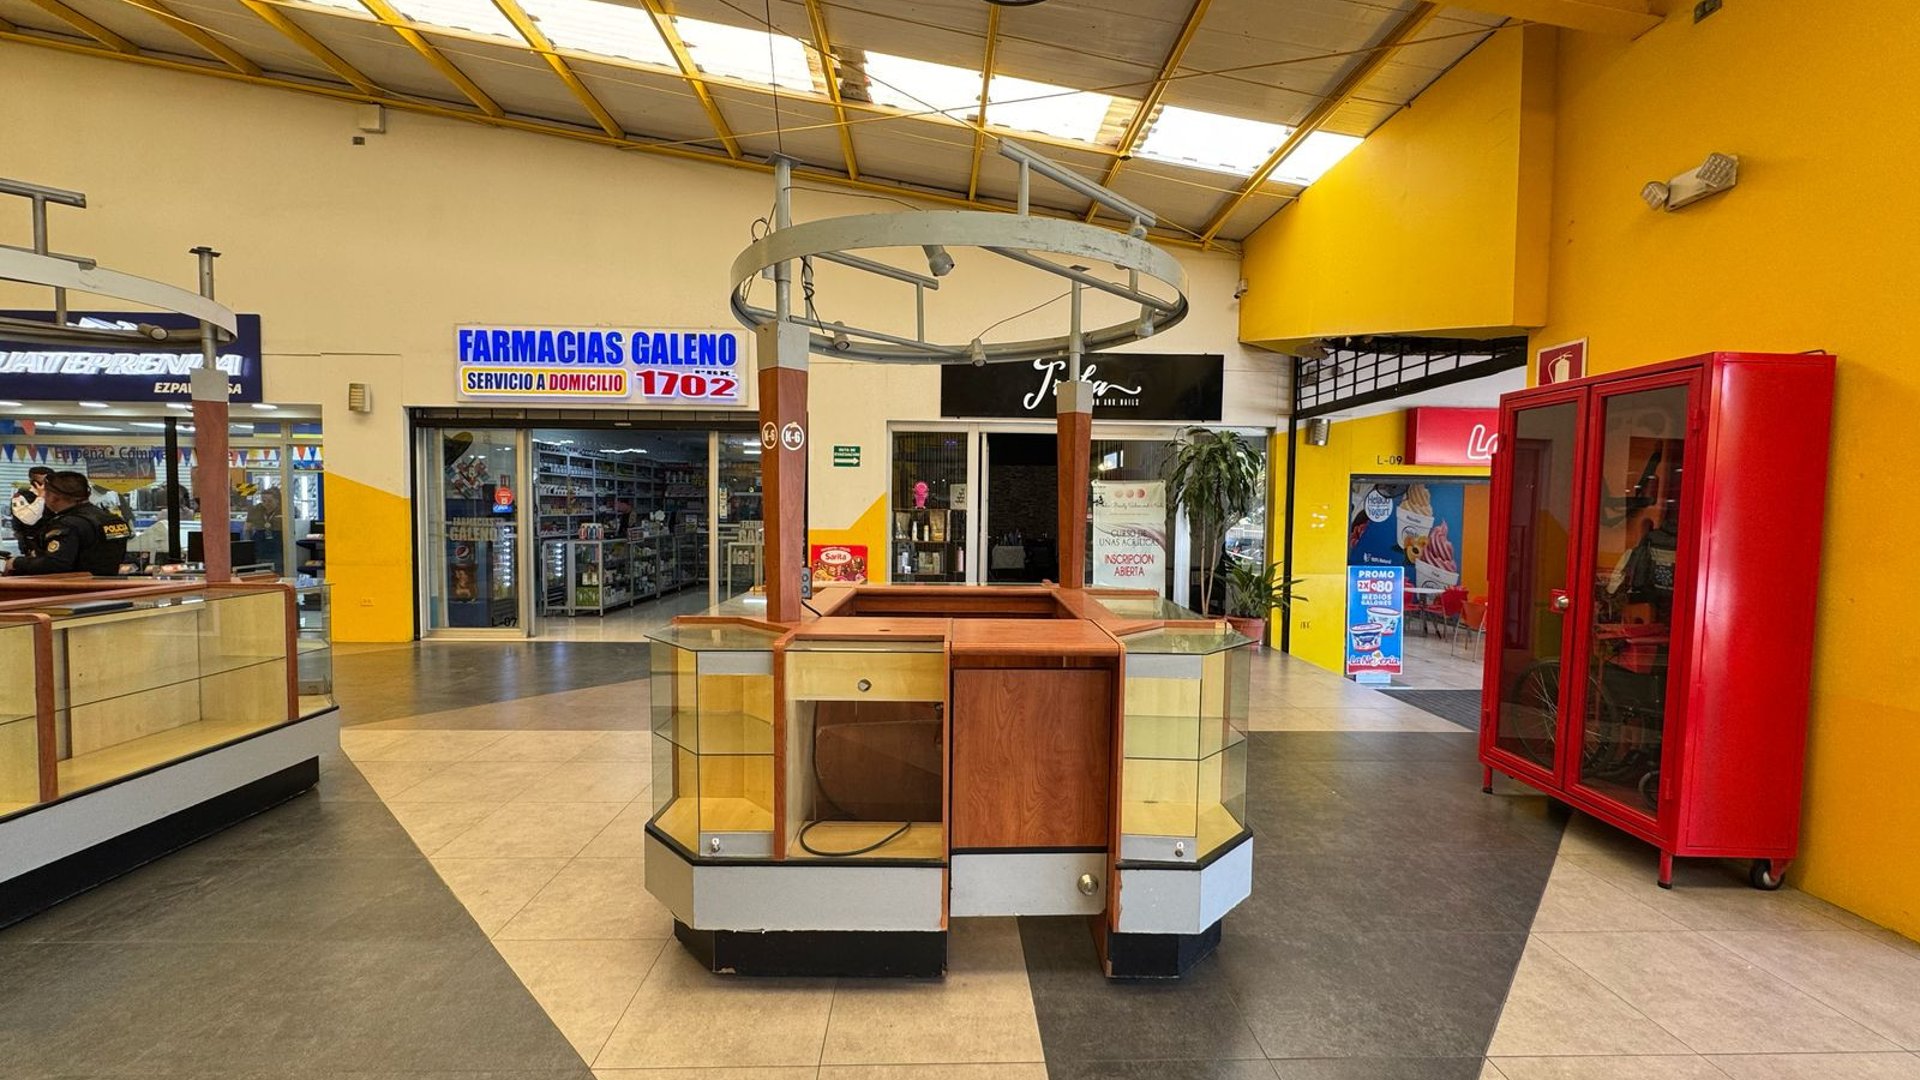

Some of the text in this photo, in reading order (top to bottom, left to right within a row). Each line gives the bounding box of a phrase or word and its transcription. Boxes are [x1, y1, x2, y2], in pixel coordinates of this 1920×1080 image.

[459, 330, 737, 366] FARMACIAS GALENO
[154, 382, 191, 394] EZPA
[468, 372, 622, 392] SERVICIO A DOMICILIO
[636, 370, 736, 397] 1702
[786, 431, 800, 443] K-6
[1377, 455, 1403, 465] L-09
[450, 527, 498, 541] GALENO
[825, 553, 847, 561] Sarita
[1114, 566, 1146, 577] ABIERTA
[1358, 570, 1396, 579] PROMO
